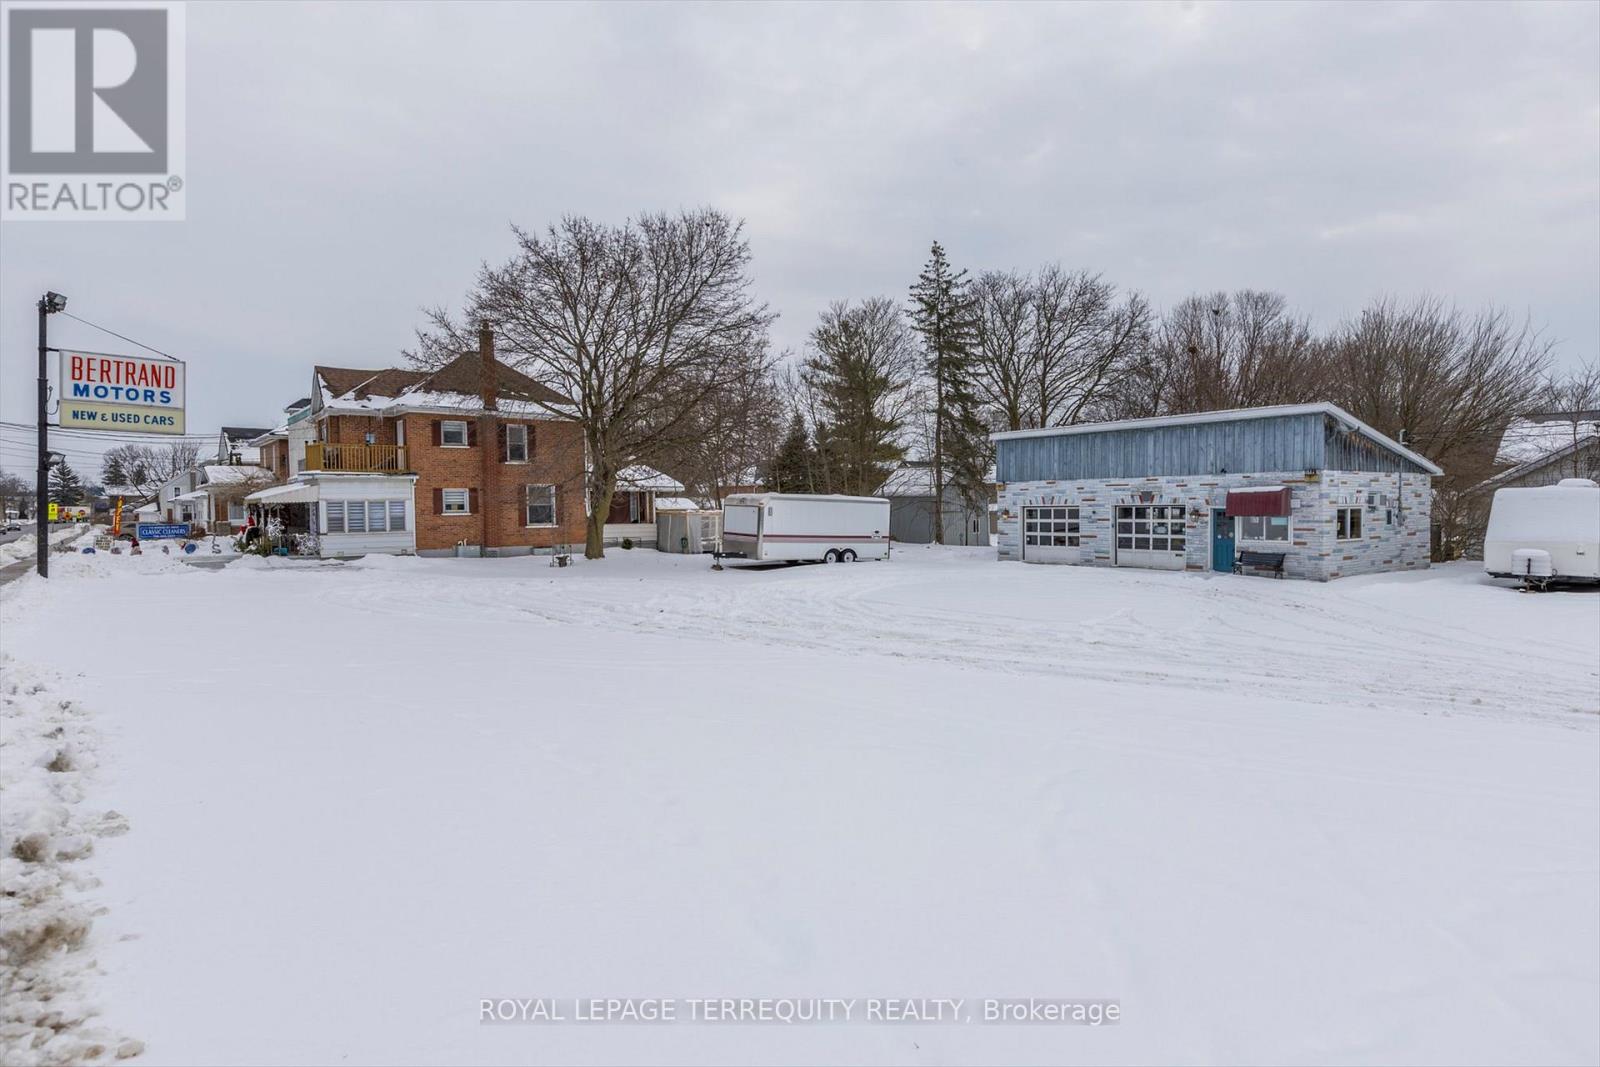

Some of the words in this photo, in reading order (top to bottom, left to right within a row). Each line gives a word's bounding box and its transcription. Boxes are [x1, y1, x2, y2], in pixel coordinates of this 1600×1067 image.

[71, 356, 176, 389] BERTRAND
[73, 383, 171, 404] MOTORS
[72, 410, 98, 421] NEW
[111, 412, 140, 424] USED
[144, 415, 175, 426] CARS
